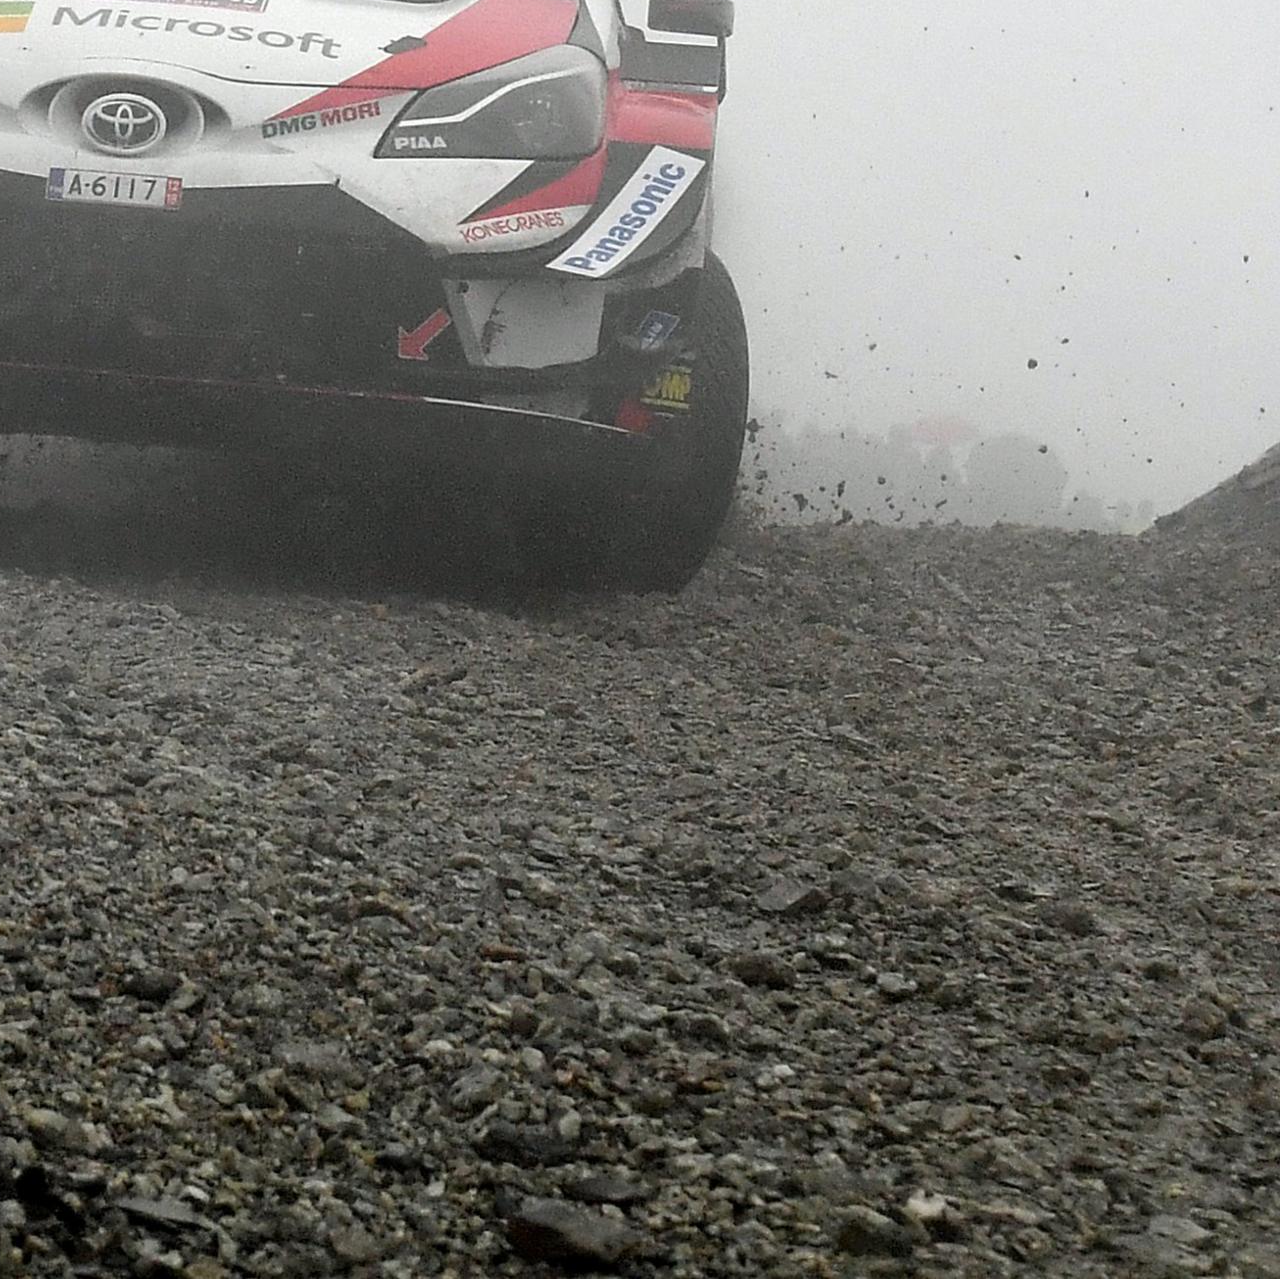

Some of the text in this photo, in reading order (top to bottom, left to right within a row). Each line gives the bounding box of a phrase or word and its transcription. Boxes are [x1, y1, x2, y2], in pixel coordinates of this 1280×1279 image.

[51, 6, 342, 60] Microsoft
[261, 101, 382, 140] DMG MORI
[393, 136, 448, 151] PIAA
[67, 173, 157, 201] A-6117
[459, 211, 566, 244] KONECRANES
[563, 162, 686, 271] Panasonic
